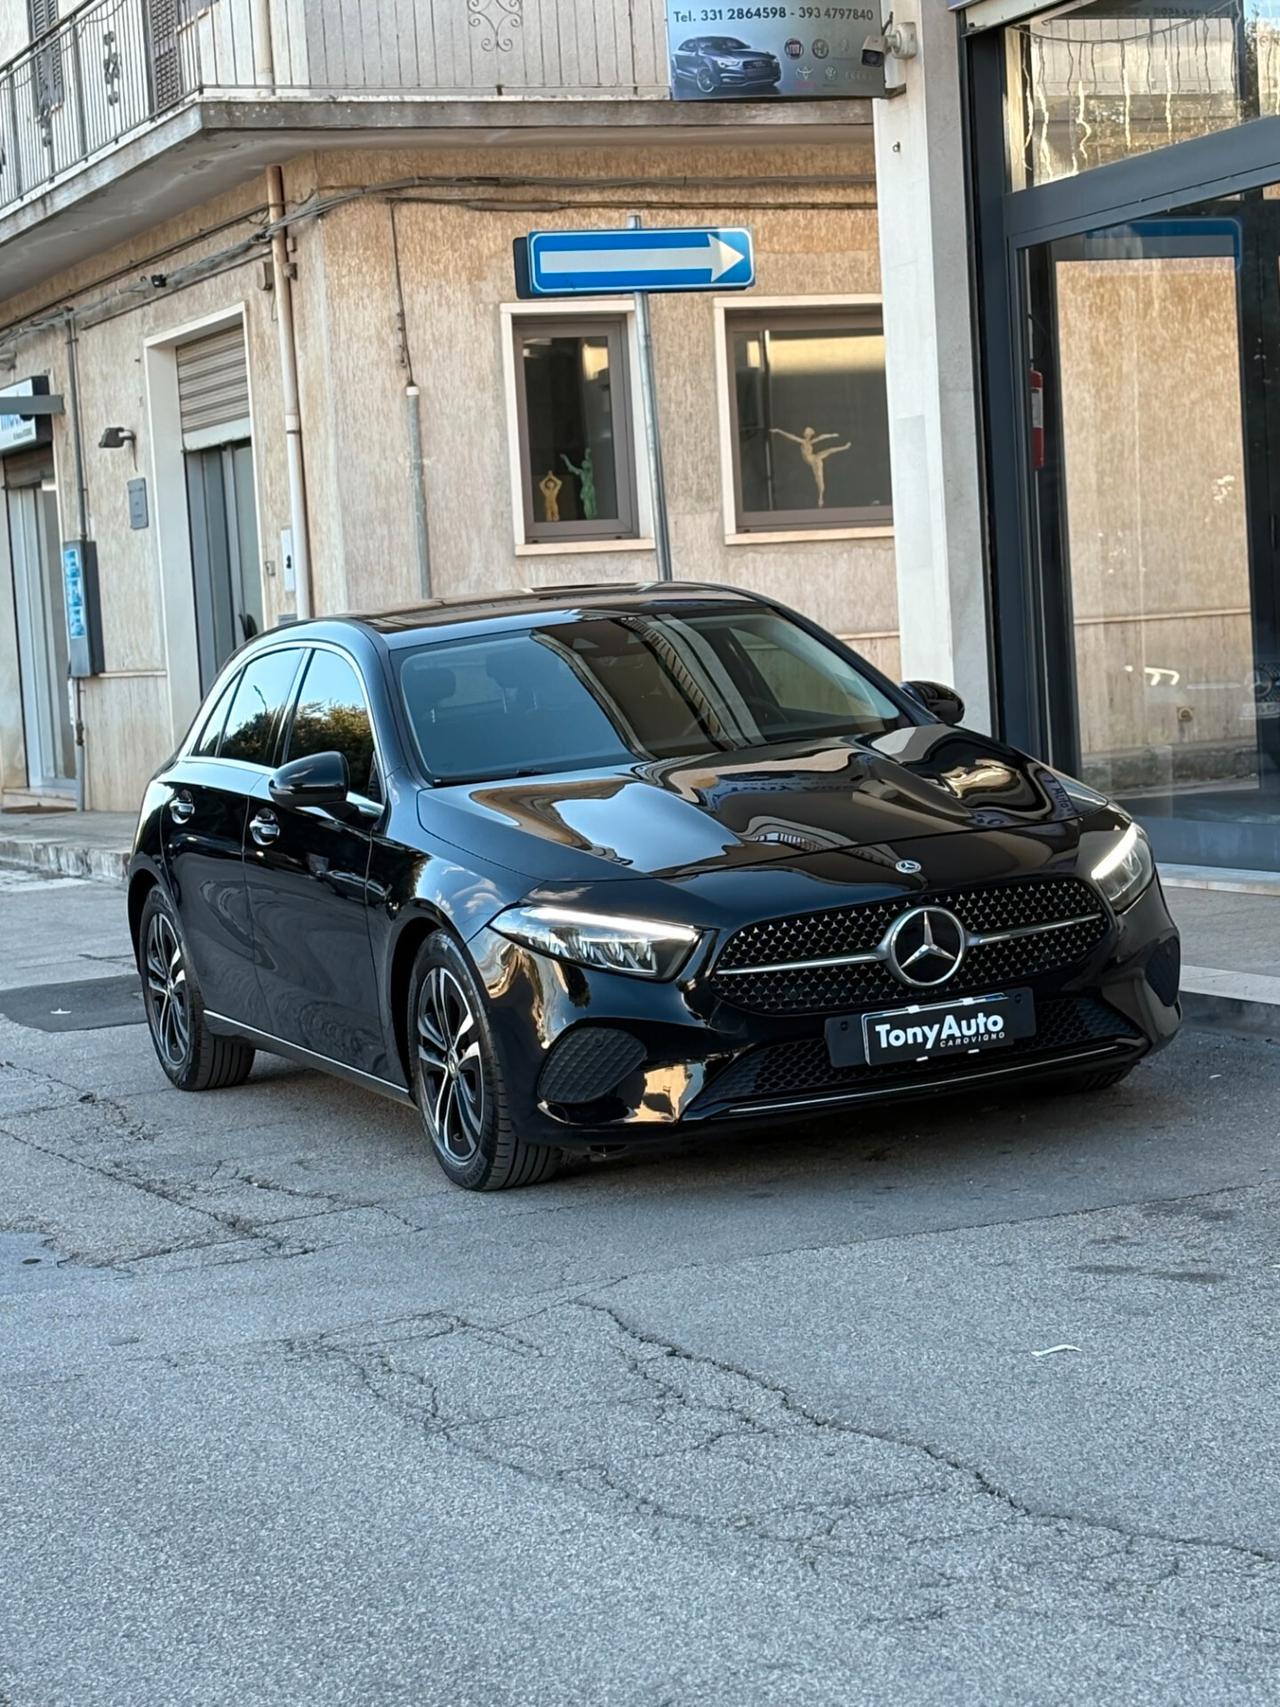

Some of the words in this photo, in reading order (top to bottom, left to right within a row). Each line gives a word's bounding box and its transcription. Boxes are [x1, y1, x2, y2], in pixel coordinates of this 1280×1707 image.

[673, 11, 696, 23] Tel.
[700, 9, 723, 21] 331
[727, 7, 786, 20] 2864598
[799, 7, 821, 18] 393
[824, 8, 873, 21] 4797840
[939, 1031, 1006, 1048] CAROVIGNO
